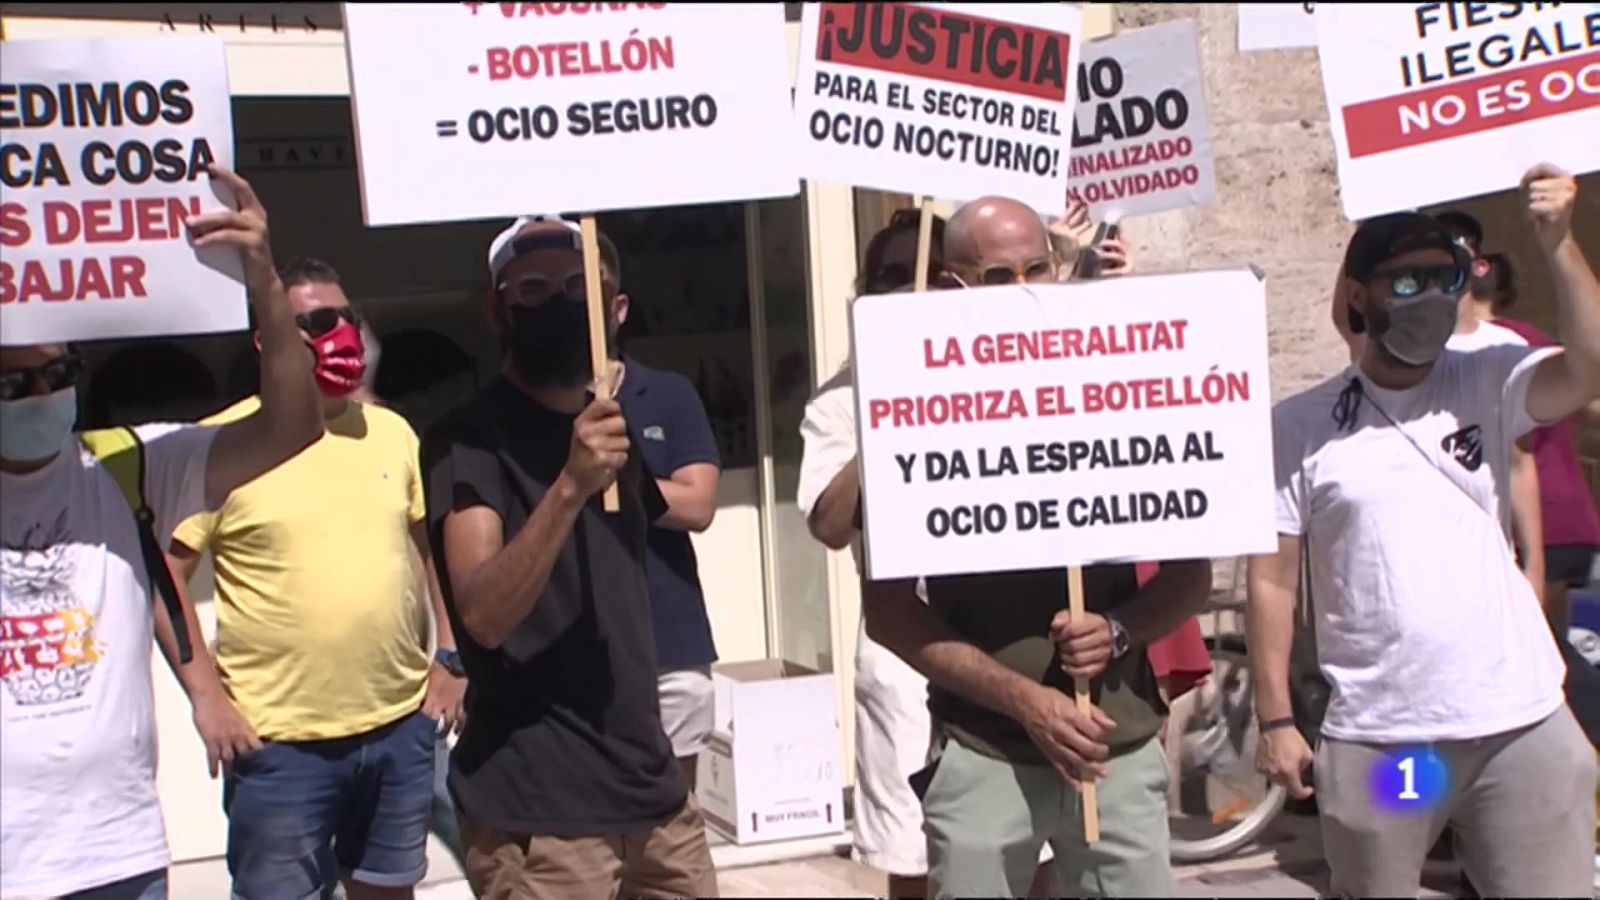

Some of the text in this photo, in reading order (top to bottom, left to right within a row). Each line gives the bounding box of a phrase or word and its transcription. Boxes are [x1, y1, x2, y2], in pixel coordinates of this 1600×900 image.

[822, 3, 1066, 90] ¡JUSTICIA
[1415, 3, 1562, 38] FIES
[486, 28, 675, 81] BOTELLÓN
[1400, 13, 1600, 87] ILEGALE
[0, 79, 194, 129] EDIMOS
[468, 104, 560, 144] OCIO
[566, 93, 719, 137] SEGURO
[814, 71, 1062, 136] PARA EL SECTOR DEL
[1398, 62, 1600, 134] NO ES OC
[0, 137, 216, 189] CA COSA
[809, 109, 1060, 178] OCIO NOCTURNO!
[1068, 136, 1193, 179] INALIZADO
[1084, 164, 1199, 203] OLVIDADO
[0, 195, 201, 247] S DEJEN
[923, 319, 1188, 368] LA GENERALITAT
[869, 365, 1250, 429] PRIORIZA EL BOTELLÓN
[895, 431, 1224, 484] Y DA LA ESPALDA AL
[926, 488, 1209, 538] OCIO DE CALIDAD
